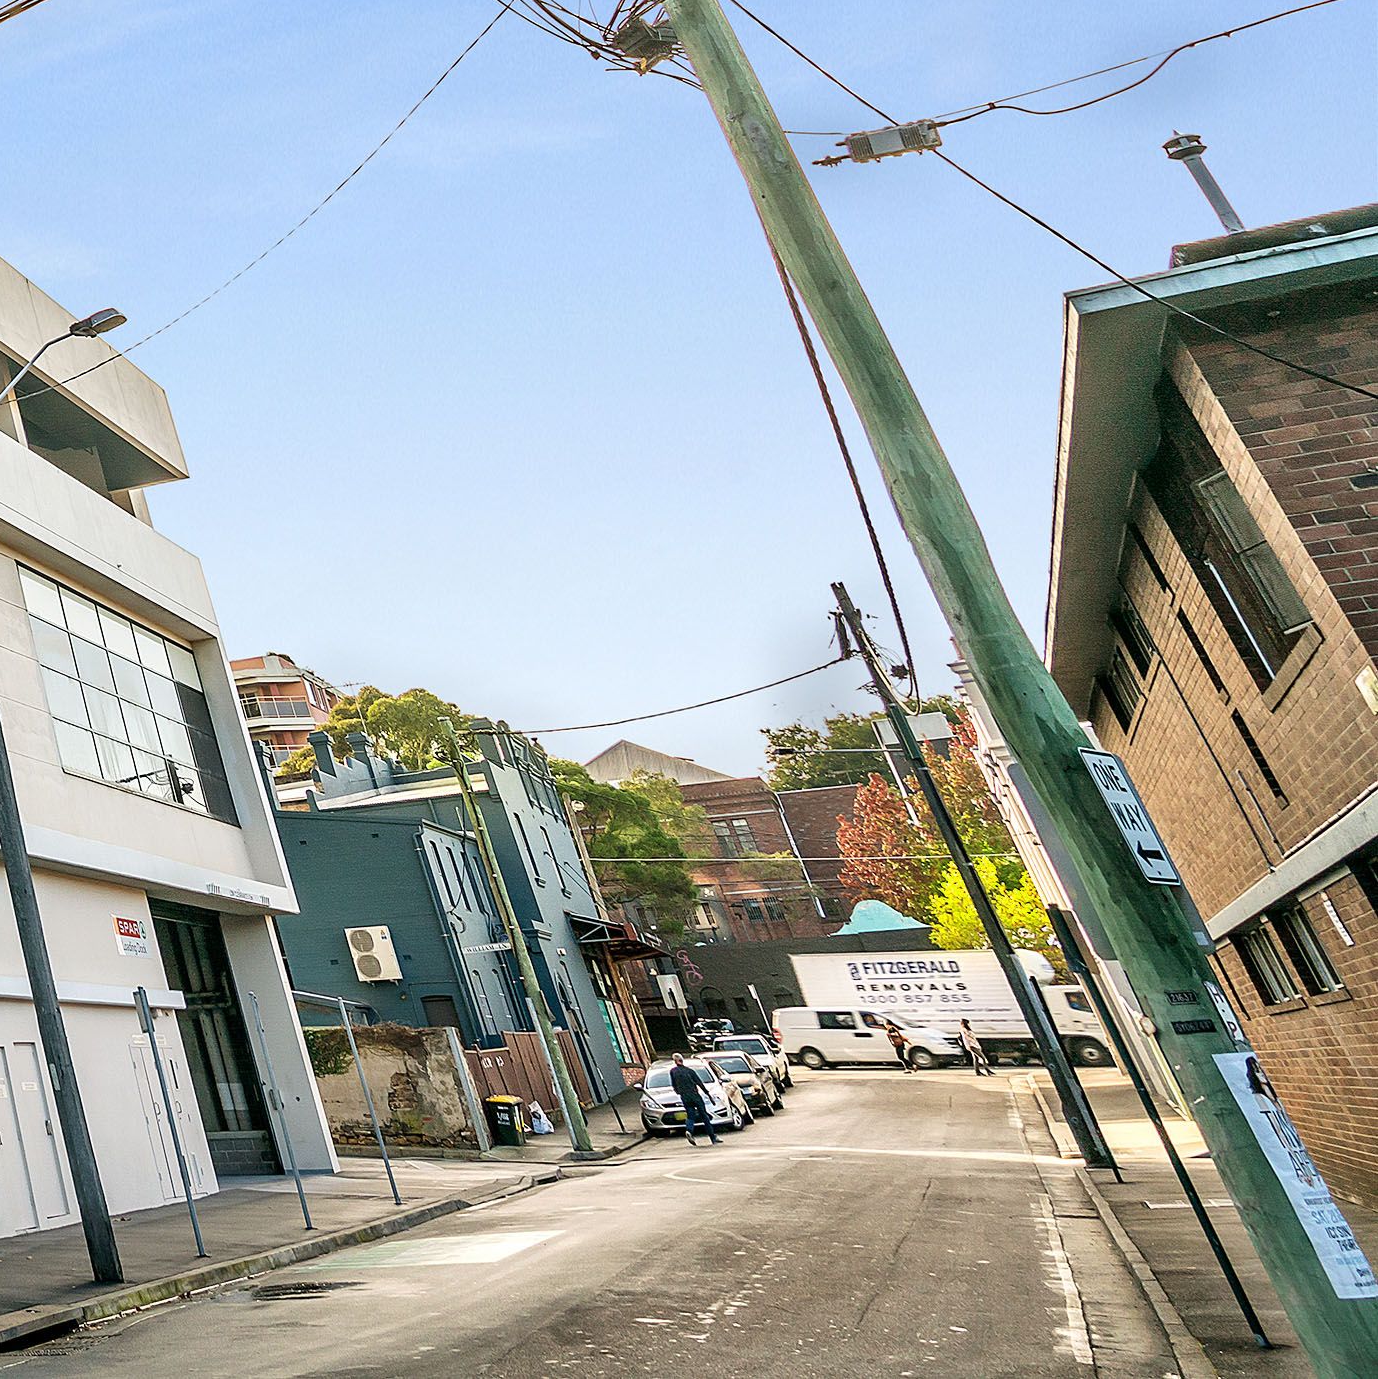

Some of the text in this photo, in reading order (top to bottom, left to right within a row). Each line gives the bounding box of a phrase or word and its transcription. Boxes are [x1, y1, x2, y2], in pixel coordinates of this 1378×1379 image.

[1092, 761, 1128, 793] ONE
[1110, 802, 1148, 832] WAY
[118, 920, 141, 935] SPAR
[862, 960, 961, 975] FITZGERALD
[856, 982, 968, 992] REMOVALS
[861, 993, 972, 1004] 1300 857 855
